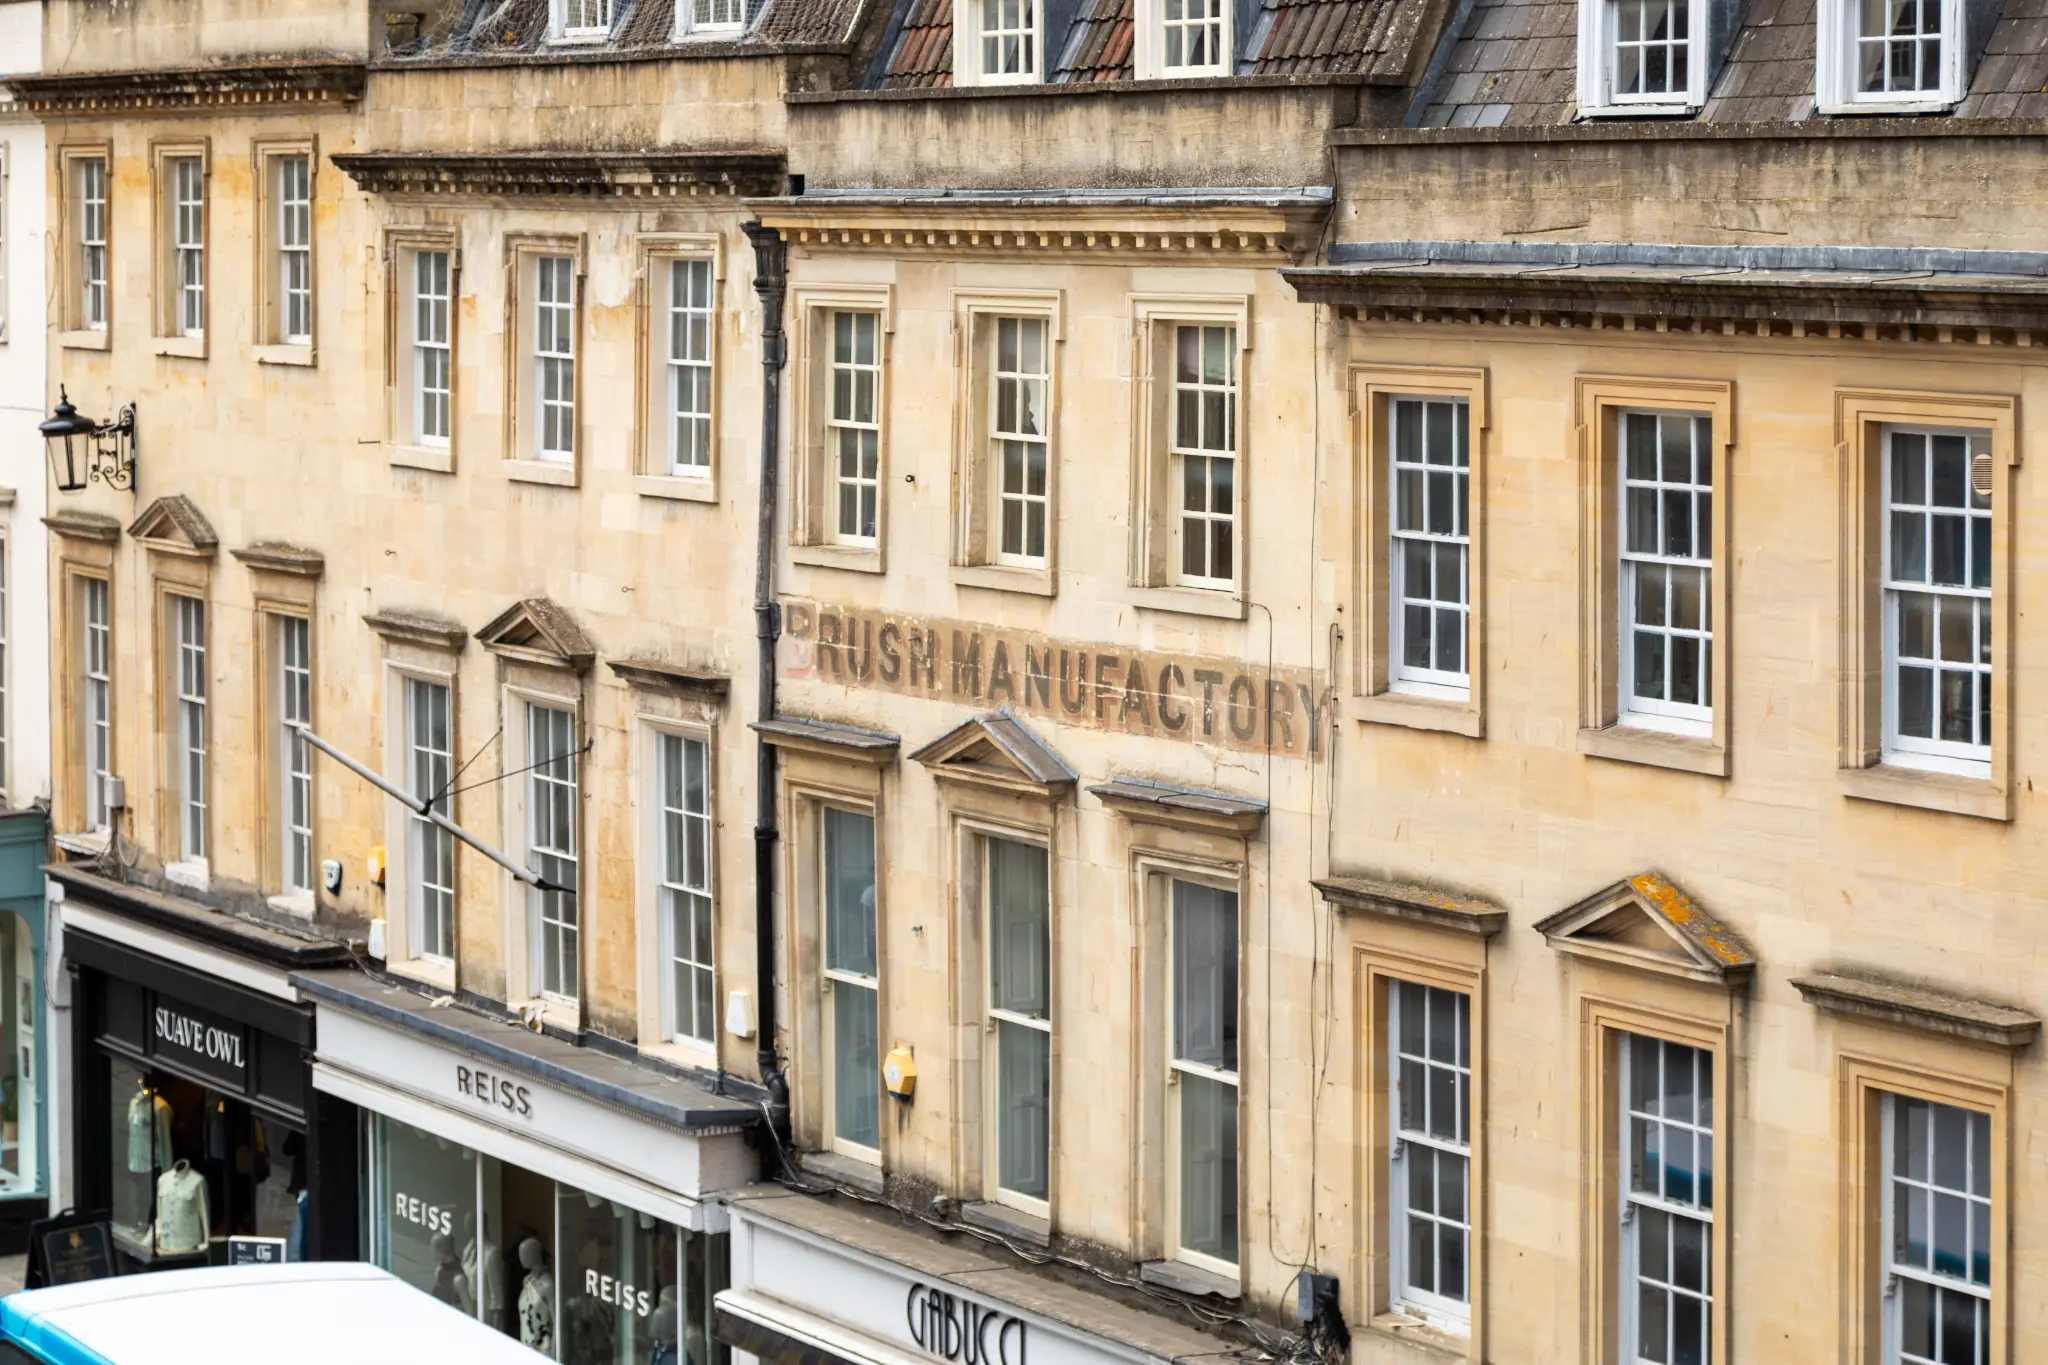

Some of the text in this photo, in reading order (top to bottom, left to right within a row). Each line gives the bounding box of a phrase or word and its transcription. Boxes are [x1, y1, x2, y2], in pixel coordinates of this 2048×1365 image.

[786, 604, 1334, 753] BRUSH MANUFACTORY
[155, 1006, 246, 1068] SUAVE OWL
[456, 1065, 532, 1115] REISS
[395, 1192, 452, 1236] REISS
[585, 1268, 650, 1317] REISS
